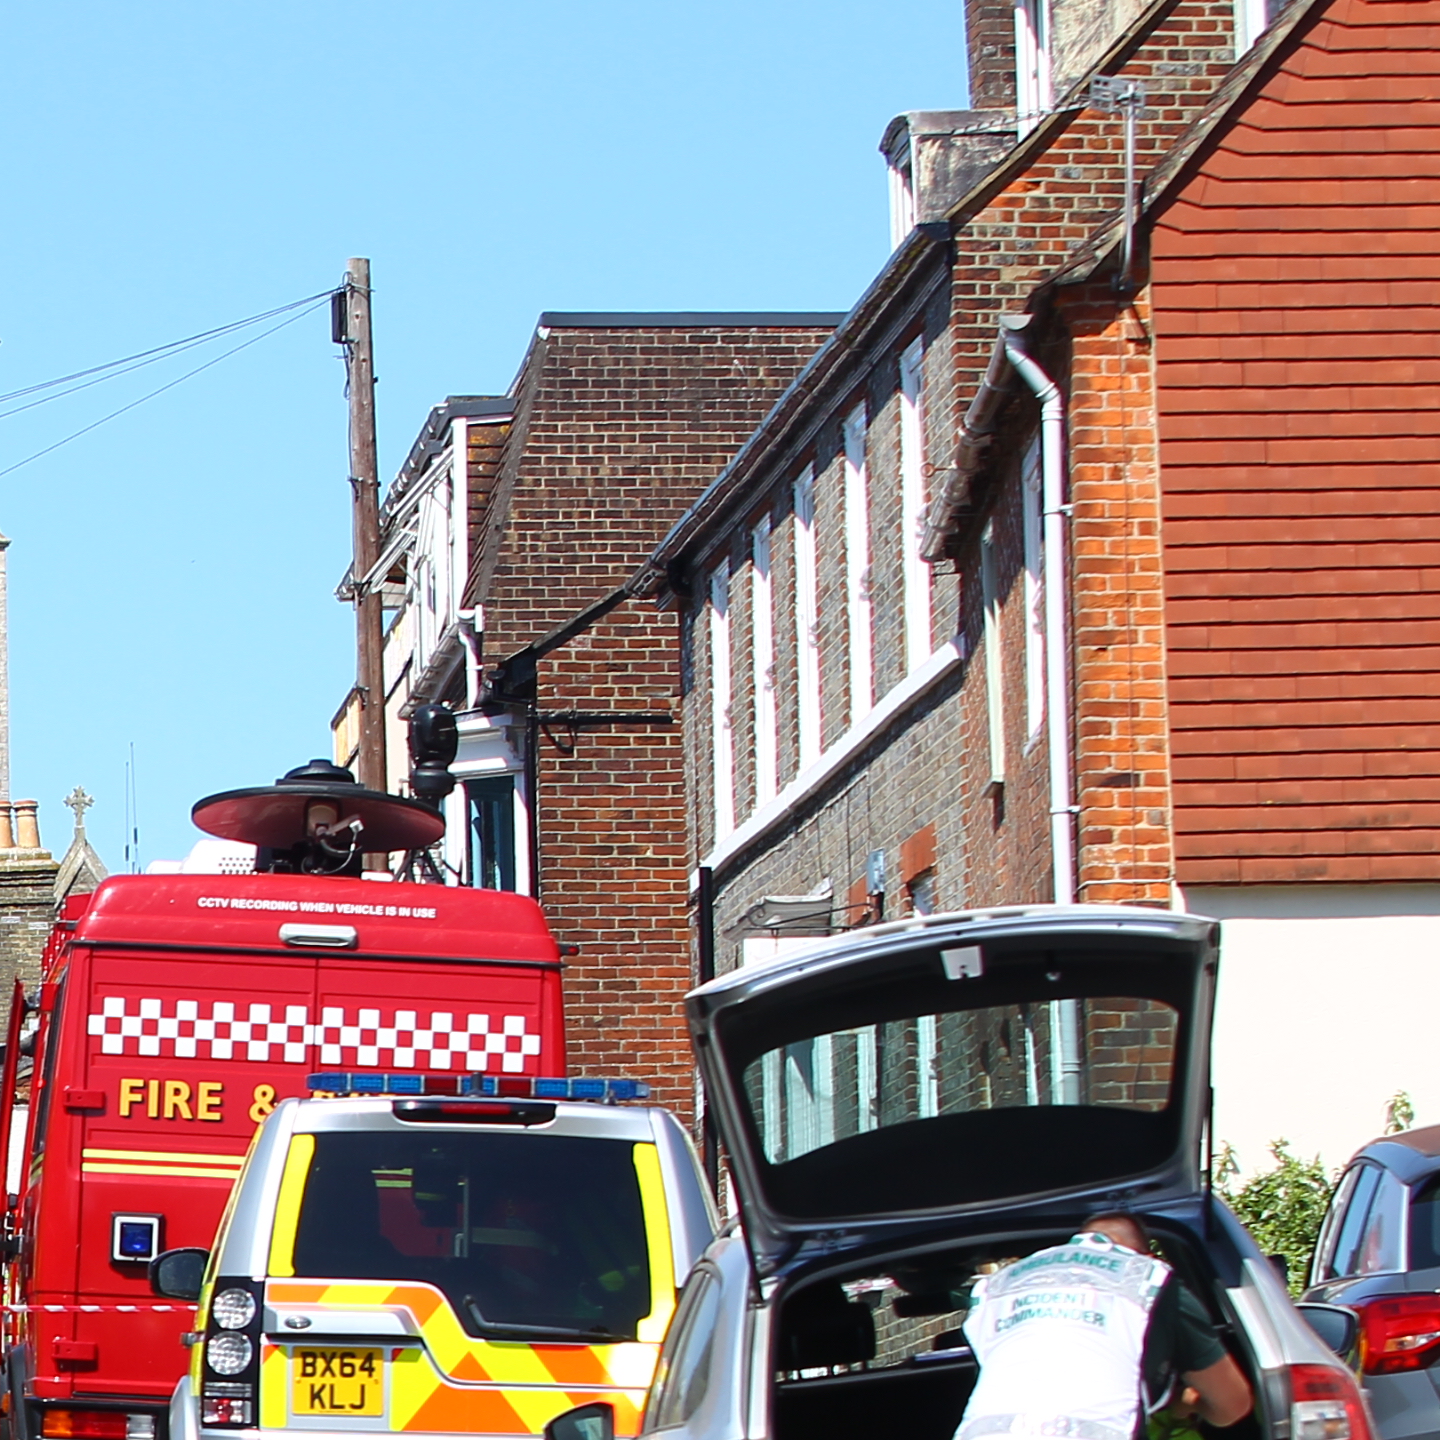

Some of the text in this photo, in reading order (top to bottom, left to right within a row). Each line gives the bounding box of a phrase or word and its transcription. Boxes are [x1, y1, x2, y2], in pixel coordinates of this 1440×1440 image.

[198, 897, 436, 918] CCTV RECORDING WHEN VEHICLE IS IN USE
[119, 1078, 276, 1123] FIRE &
[301, 1351, 375, 1378] BX64
[309, 1383, 366, 1410] KLJ
